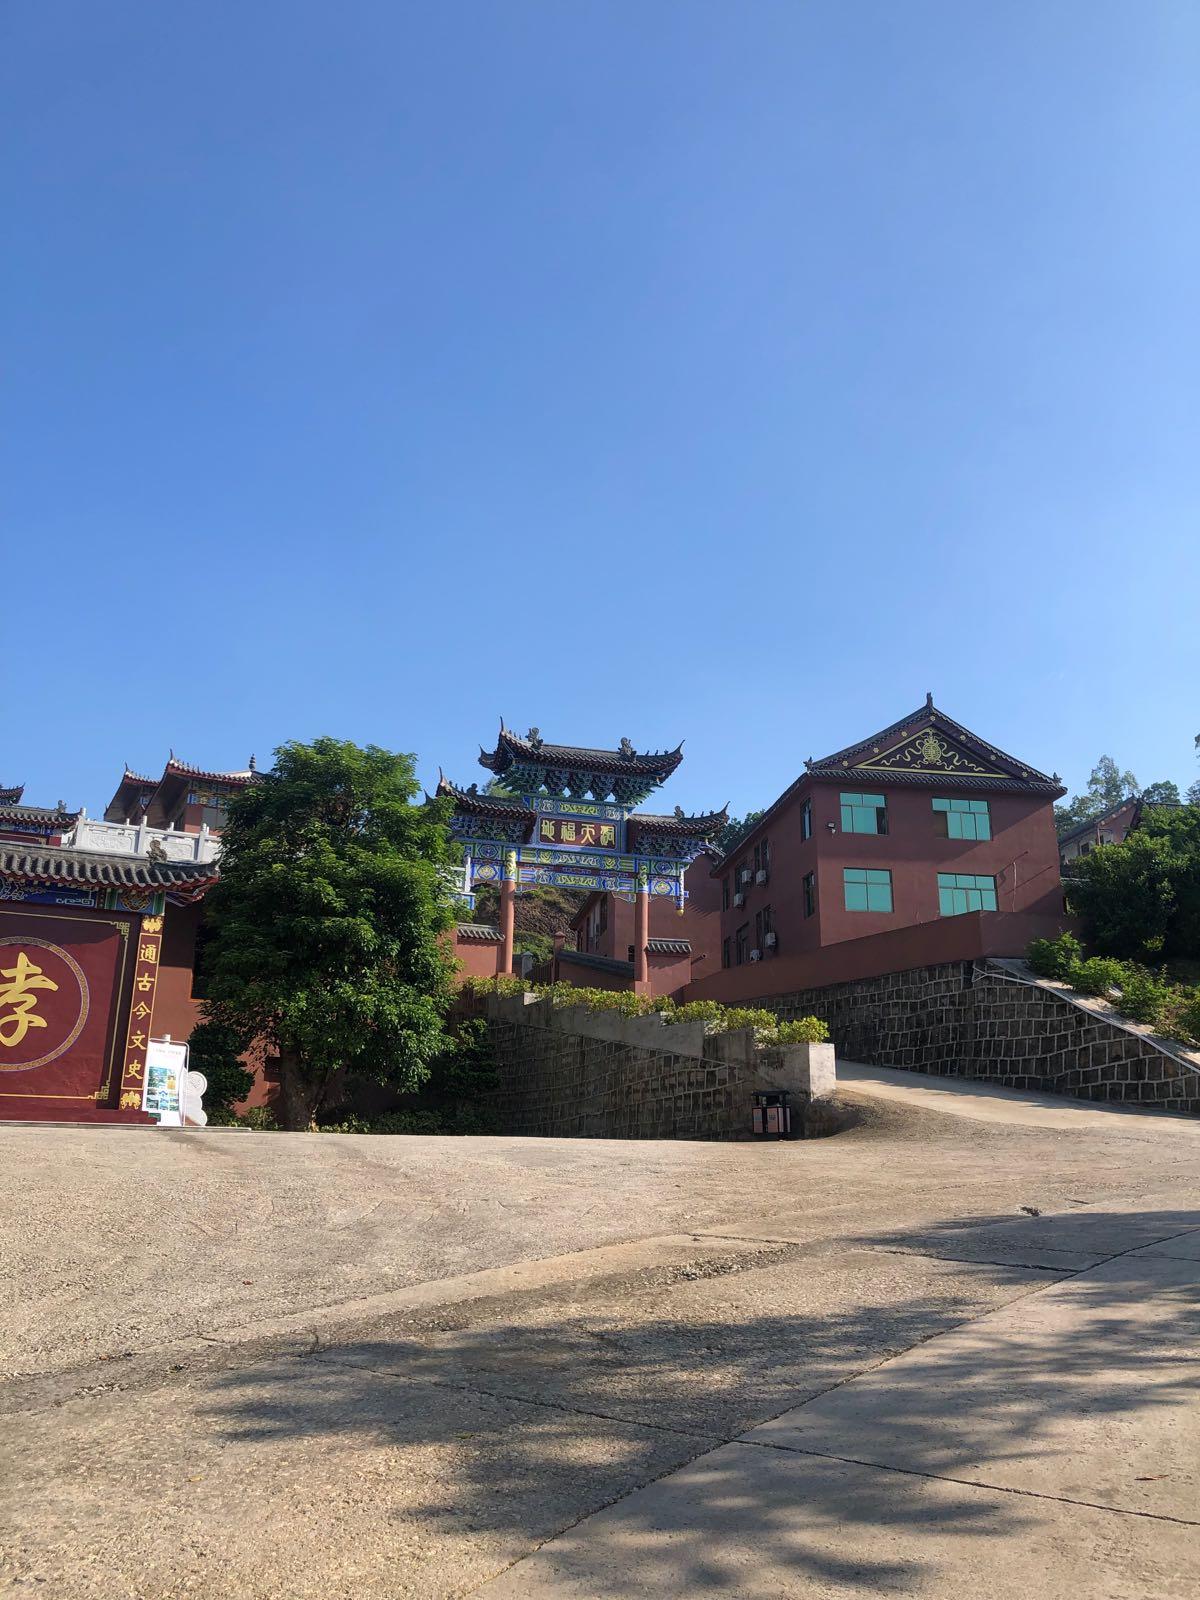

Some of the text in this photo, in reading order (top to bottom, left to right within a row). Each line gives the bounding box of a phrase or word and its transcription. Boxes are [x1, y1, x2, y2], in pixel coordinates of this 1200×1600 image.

[0, 952, 59, 1047] 孝
[124, 944, 158, 1080] 通古今文史
